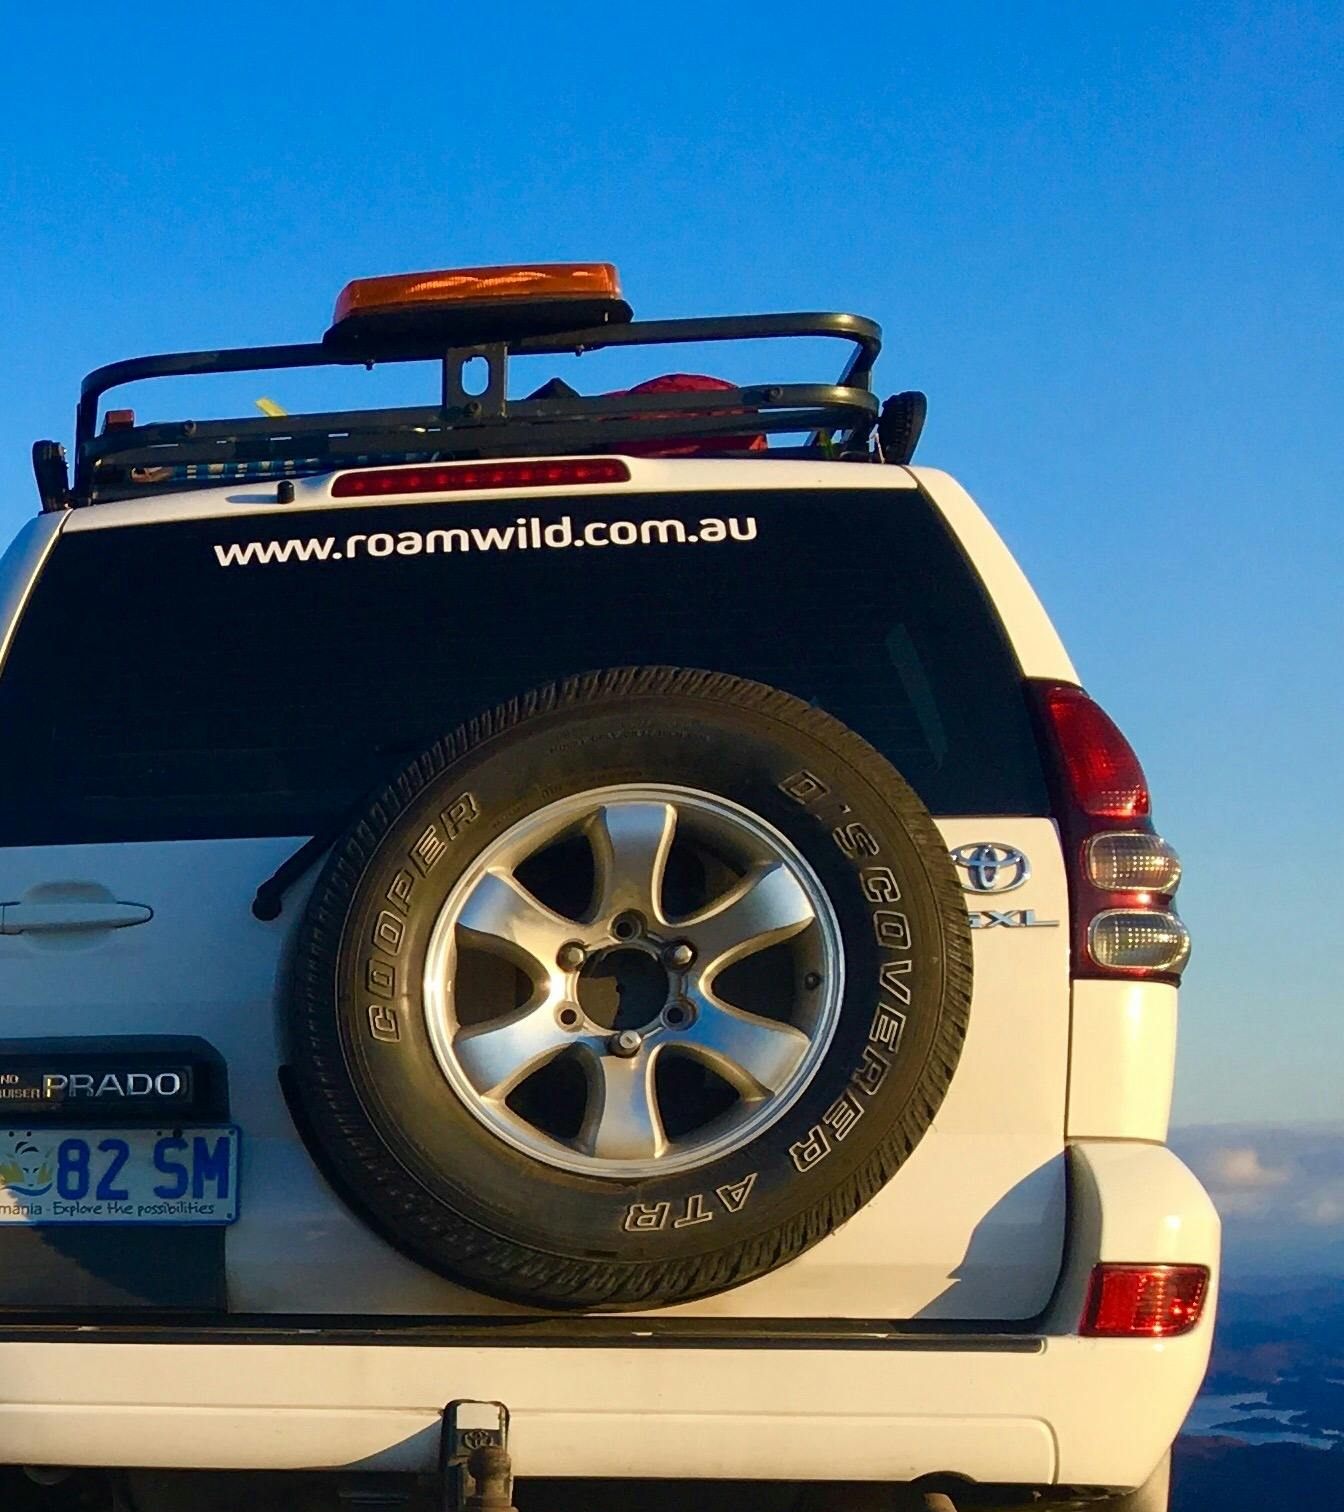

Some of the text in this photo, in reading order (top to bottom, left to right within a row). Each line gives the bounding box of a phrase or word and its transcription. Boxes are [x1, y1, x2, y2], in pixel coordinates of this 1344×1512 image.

[213, 515, 759, 567] www.roamwild.com.au
[367, 791, 481, 1043] COOPER
[42, 1073, 181, 1098] PRADO
[56, 1138, 131, 1200] 82
[153, 1136, 230, 1200] SM
[53, 1201, 103, 1217] Explore
[107, 1201, 132, 1215] the
[137, 1201, 215, 1216] possibilities
[624, 1172, 758, 1232] ATR
